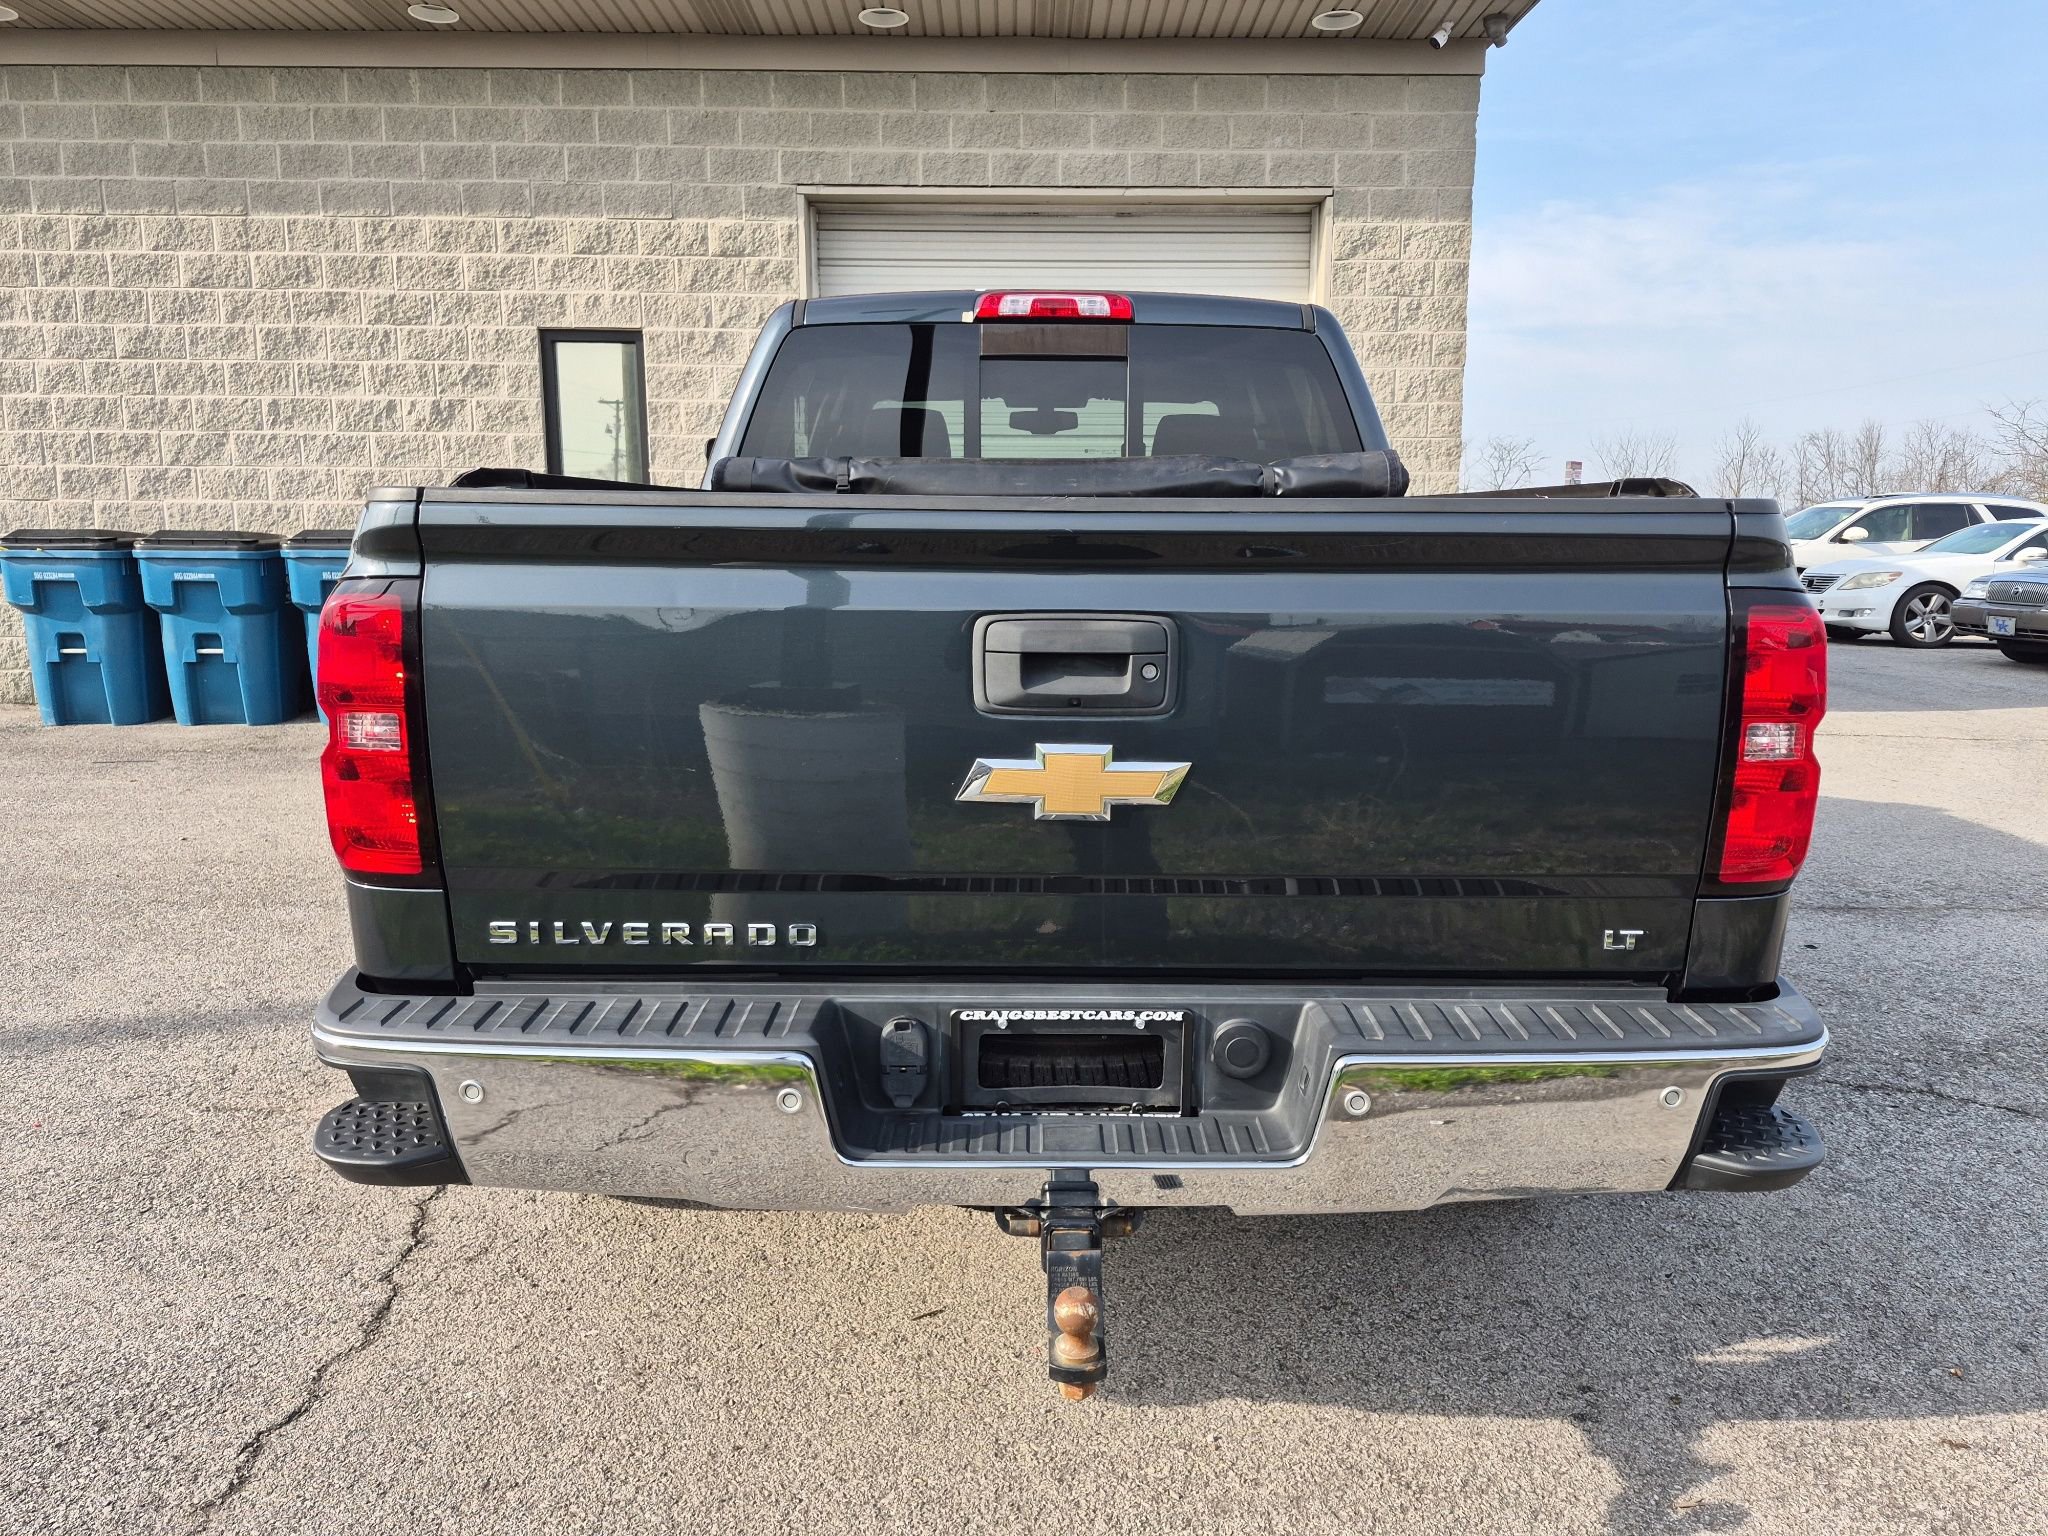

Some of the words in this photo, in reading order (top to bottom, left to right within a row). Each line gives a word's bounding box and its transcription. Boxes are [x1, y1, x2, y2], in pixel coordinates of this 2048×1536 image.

[488, 920, 818, 947] SILVERADO
[1604, 929, 1644, 951] LT
[959, 1009, 1184, 1021] CRAIGSBESTCARS.COM
